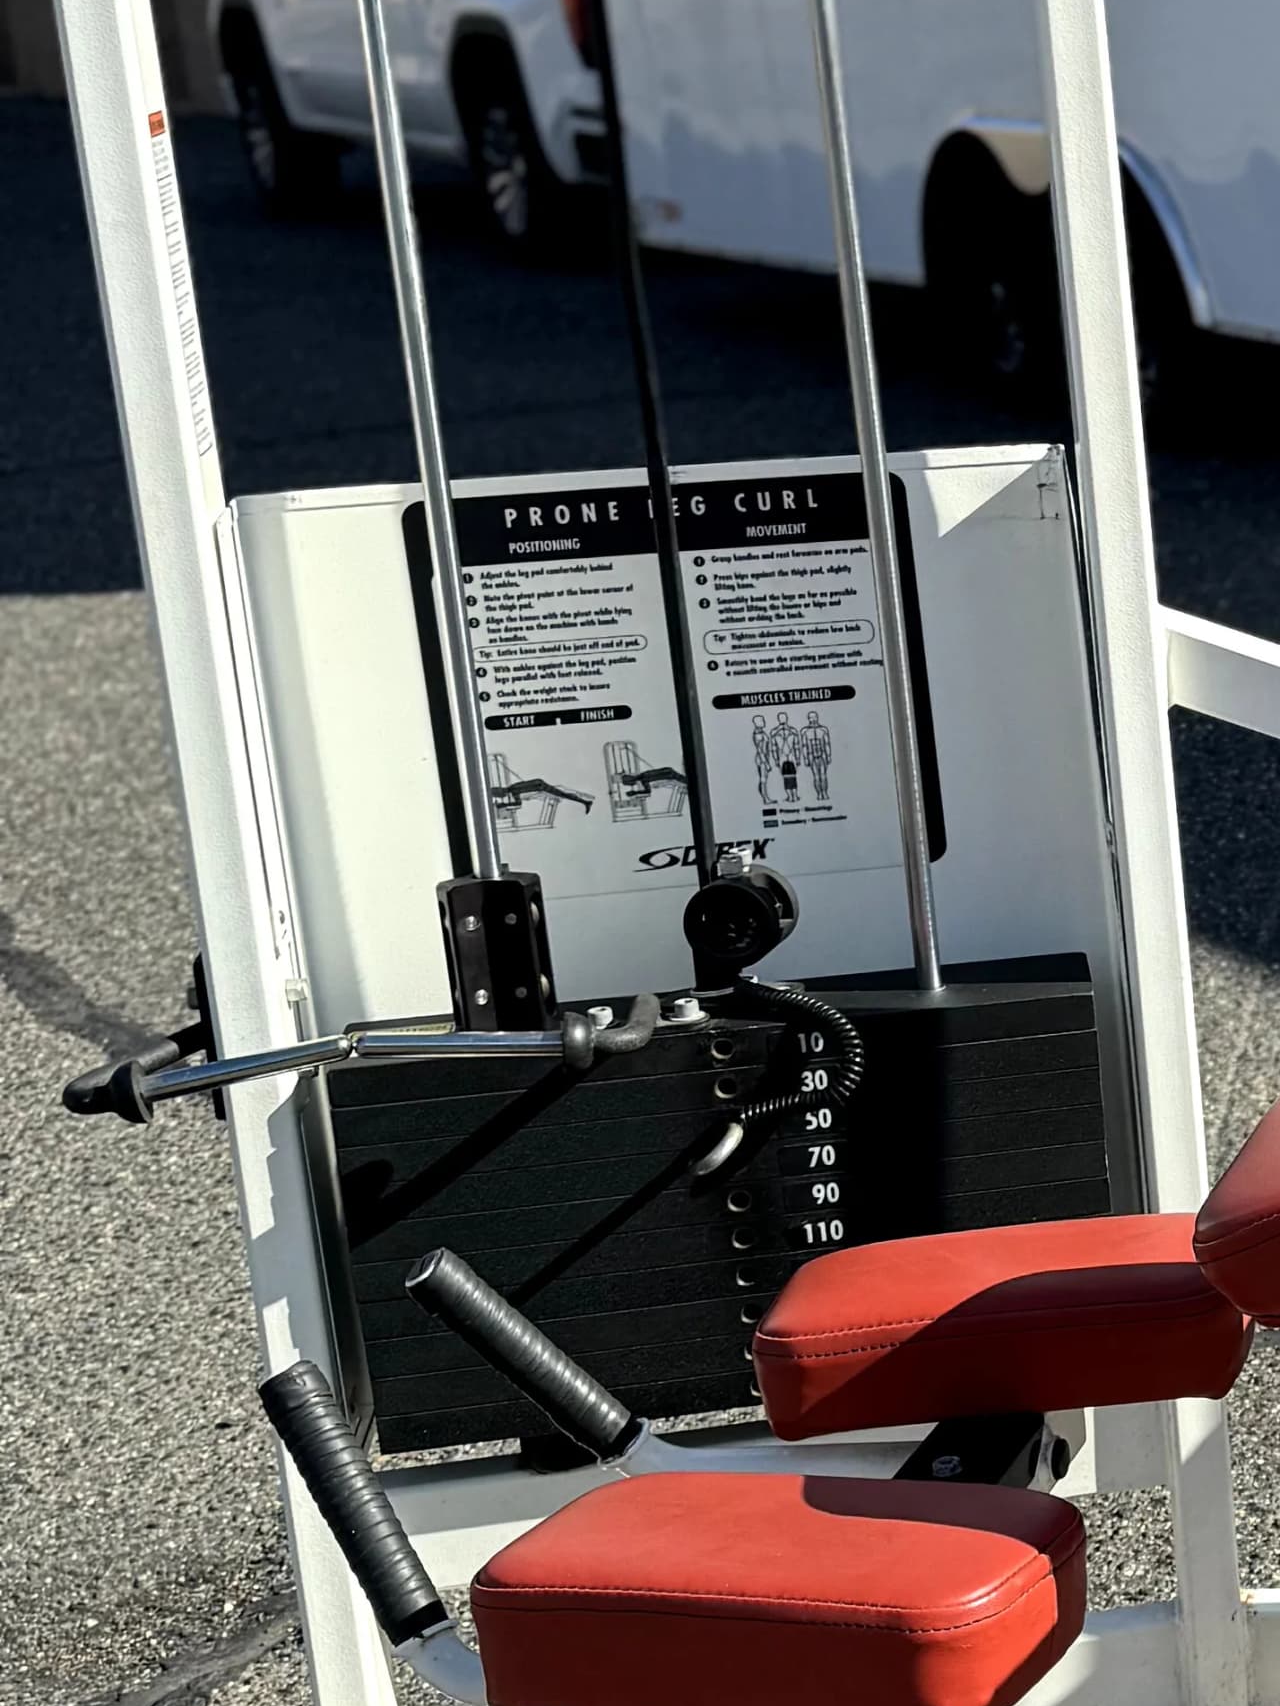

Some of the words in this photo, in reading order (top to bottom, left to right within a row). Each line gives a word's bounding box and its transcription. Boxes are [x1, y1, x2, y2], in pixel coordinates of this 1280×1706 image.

[504, 500, 620, 529] PRONE
[734, 487, 820, 514] CURL
[745, 522, 808, 538] MOVEMENT
[508, 537, 582, 555] POSITIONING
[740, 692, 786, 706] MUSCLES
[788, 688, 832, 702] TRAINED
[503, 715, 535, 728] START
[580, 708, 615, 721] FINISH
[797, 1032, 825, 1054] 10
[800, 1069, 828, 1092] 30
[804, 1107, 832, 1131] 50
[808, 1144, 836, 1168] 70
[811, 1181, 840, 1205] 90
[802, 1219, 844, 1244] 110
